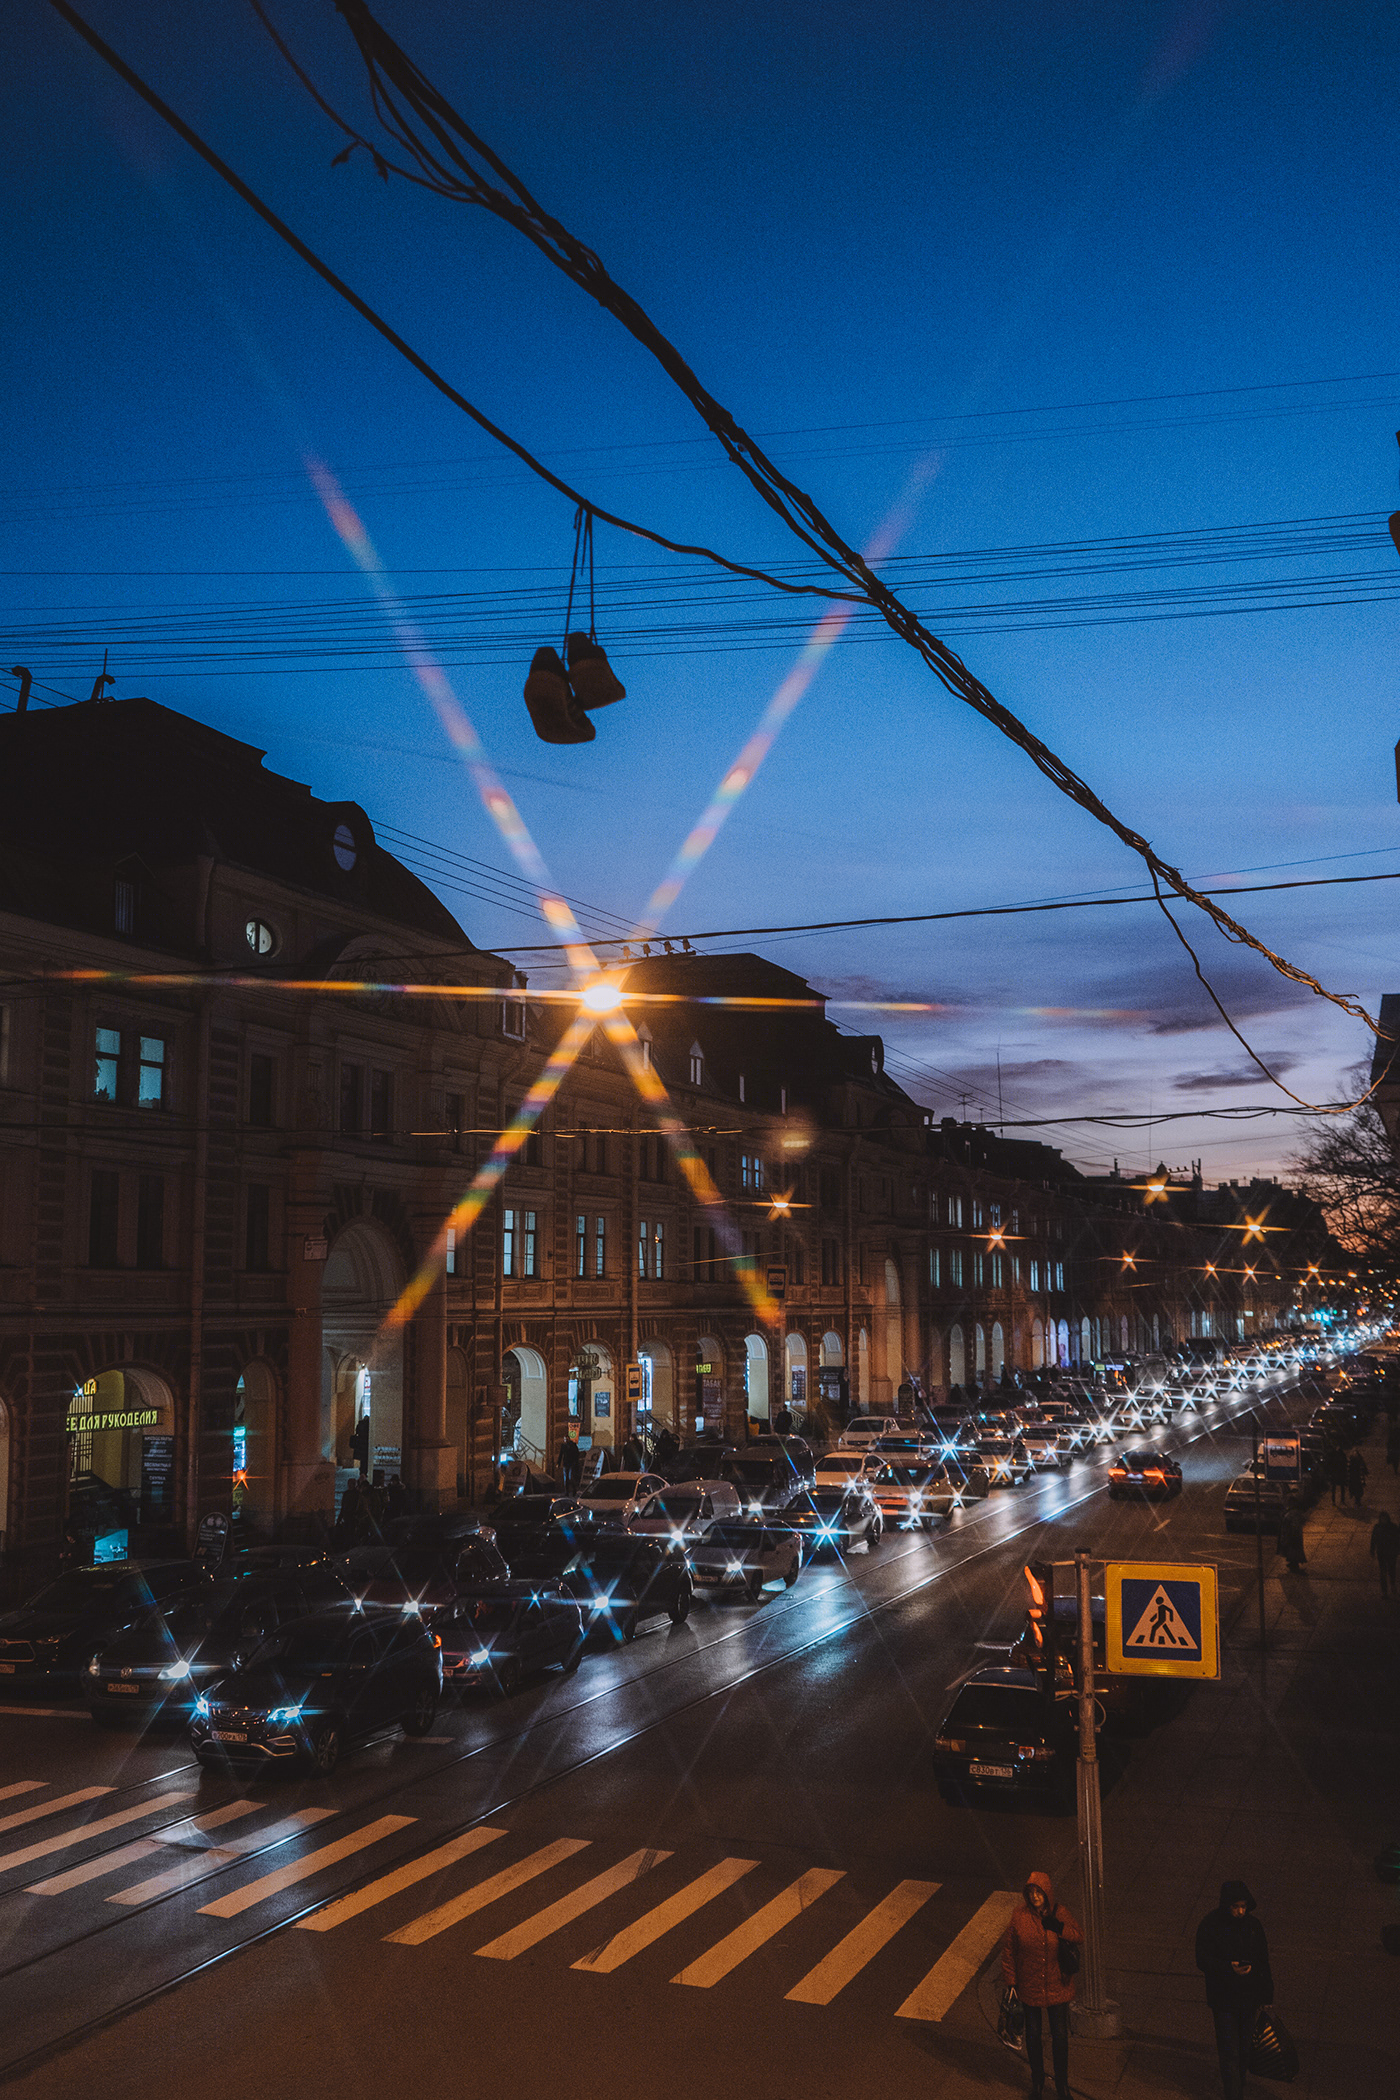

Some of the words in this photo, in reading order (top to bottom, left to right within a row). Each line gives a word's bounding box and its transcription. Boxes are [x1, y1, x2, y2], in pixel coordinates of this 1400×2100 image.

[703, 1379, 721, 1388] ТАБАК
[79, 1414, 100, 1431] ДЛЯ
[101, 1410, 158, 1429] РУКОДЕЛИЯ
